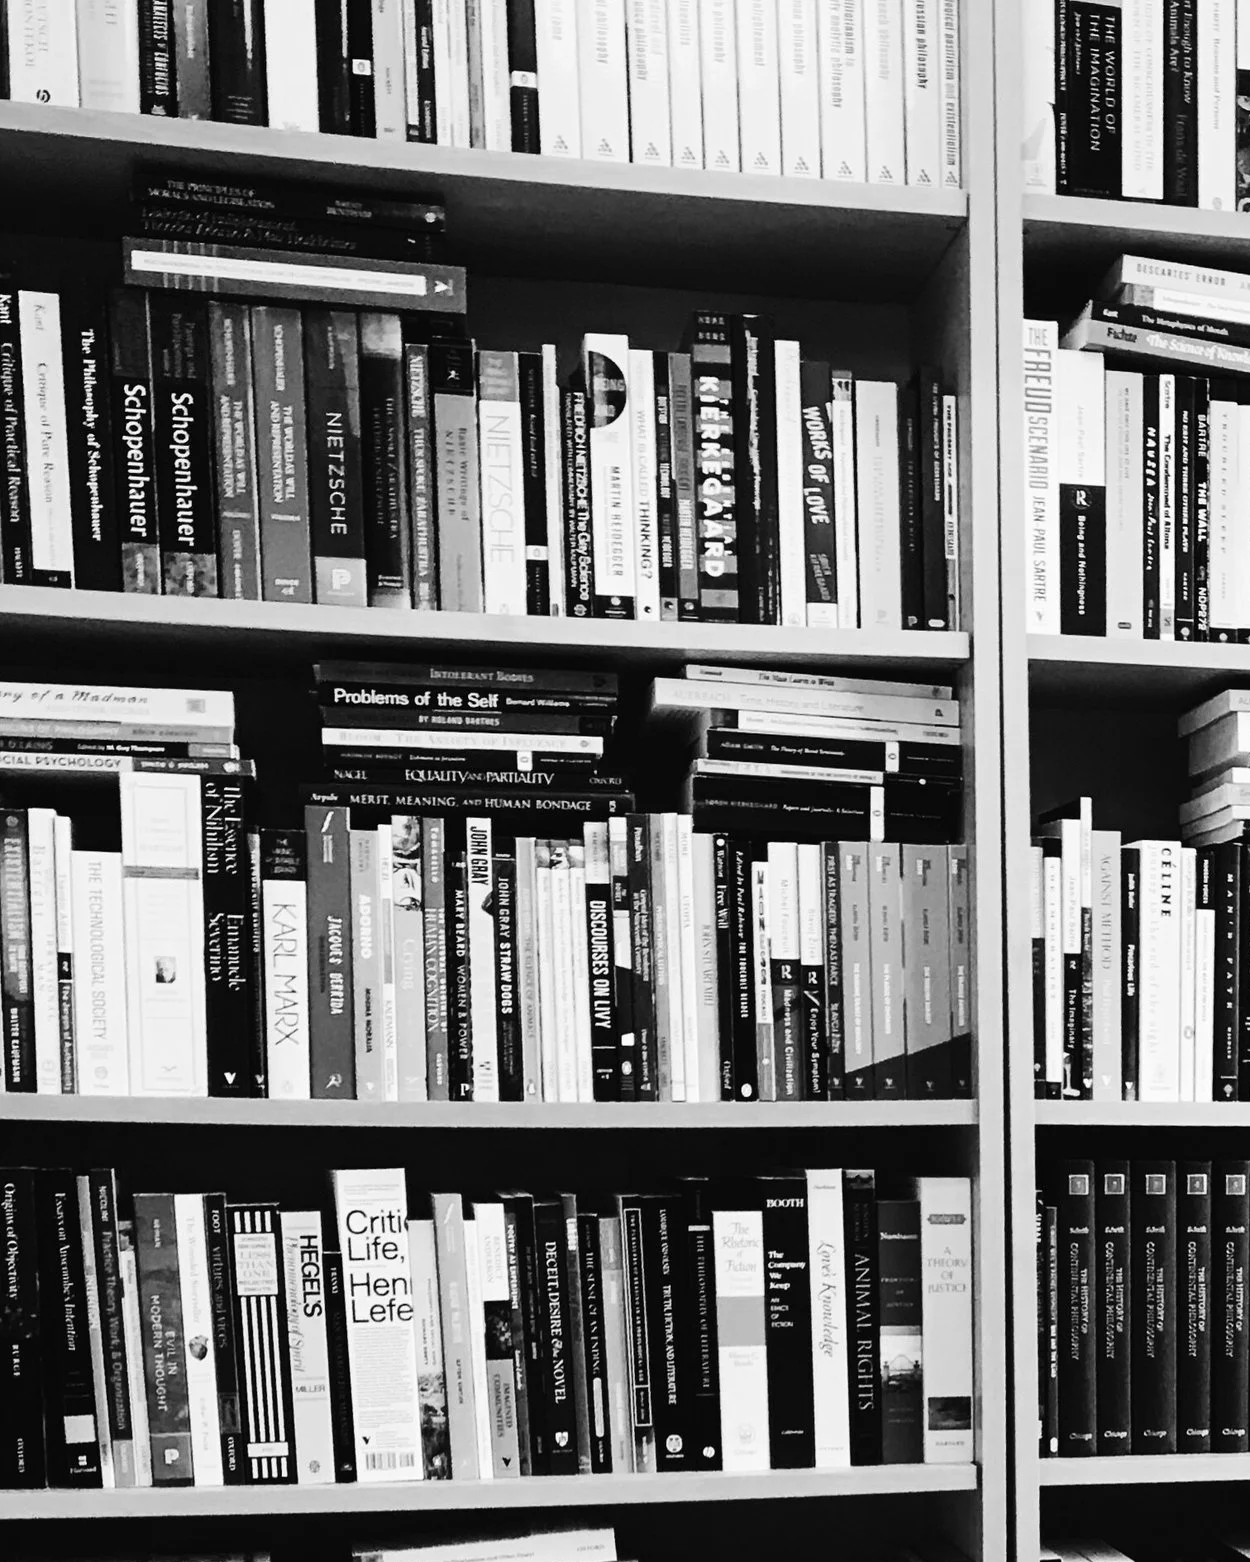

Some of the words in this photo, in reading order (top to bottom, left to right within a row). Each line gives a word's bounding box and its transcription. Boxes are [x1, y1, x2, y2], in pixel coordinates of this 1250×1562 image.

[1090, 14, 1100, 40] THE
[1106, 15, 1116, 44] THE
[1089, 48, 1100, 151] IMAGINATION
[1106, 50, 1116, 108] WORLD
[1106, 113, 1116, 134] OF
[81, 329, 94, 354] The
[81, 359, 98, 428] Philosophy
[1024, 348, 1051, 414] FREUD
[87, 432, 100, 447] of
[803, 407, 830, 460] WORKS
[1027, 416, 1049, 490] SCENARIO
[123, 383, 149, 537] Schopenhauer
[170, 392, 198, 547] Schopenhauer
[326, 412, 347, 536] NIETZSCHE
[699, 376, 724, 578] KIERKEGAARD
[807, 464, 829, 483] OF
[84, 450, 103, 542] Schopenhauer
[486, 415, 514, 563] NIETZSCHE
[805, 487, 830, 525] LOVE
[639, 500, 653, 580] THINKING?
[1033, 560, 1048, 601] SARTRE
[333, 688, 409, 706] Problems
[414, 692, 430, 706] of
[437, 693, 462, 708] the
[468, 693, 499, 708] Self
[470, 826, 487, 854] JOHN
[471, 855, 489, 886] GRAY
[498, 877, 511, 906] JOHN
[1160, 848, 1177, 918] CÉLINE
[359, 894, 373, 959] ADORNO
[454, 890, 465, 919] MARY
[499, 909, 511, 938] GRAY
[208, 912, 225, 982] Severino
[226, 914, 245, 991] Emanuele
[270, 902, 299, 969] KARL
[327, 916, 343, 964] JACQUES
[455, 923, 466, 957] BEARD
[589, 901, 610, 974] DISCOURSES
[501, 942, 512, 981] STRAW
[273, 973, 300, 1046] MARX
[329, 972, 344, 1015] DERRIDA
[456, 965, 466, 1007] WOMEN
[502, 984, 513, 1014] DOGS
[592, 979, 610, 996] ON
[593, 1000, 612, 1029] LIVY
[458, 1021, 468, 1060] POWER
[818, 1240, 838, 1279] Love's
[548, 1292, 563, 1336] DESIRE
[854, 1253, 871, 1332] ANIMAL
[150, 1295, 164, 1347] MODERN
[819, 1282, 837, 1358] Knowledge
[153, 1350, 167, 1411] THOUGHT
[552, 1359, 566, 1403] NOVEL
[857, 1340, 874, 1410] RIGHTS
